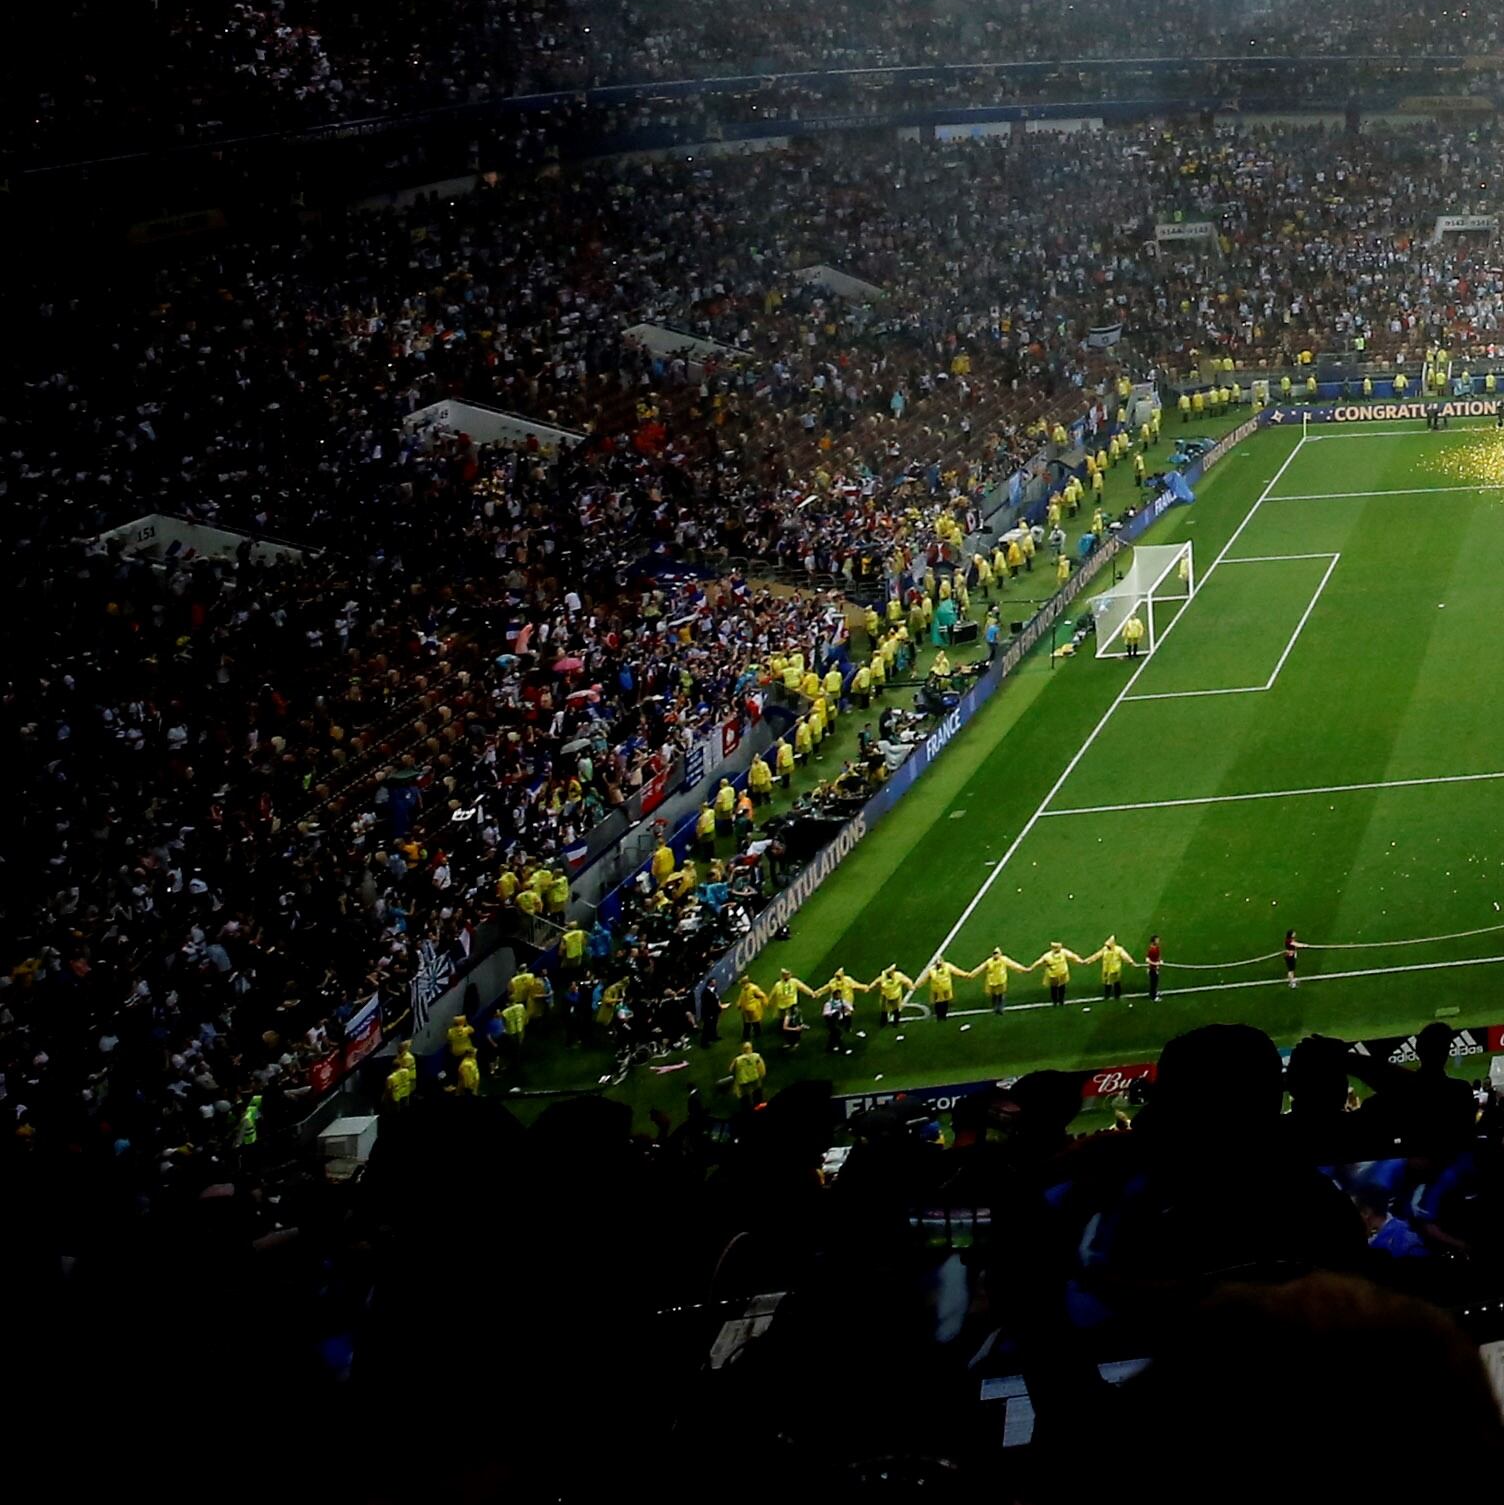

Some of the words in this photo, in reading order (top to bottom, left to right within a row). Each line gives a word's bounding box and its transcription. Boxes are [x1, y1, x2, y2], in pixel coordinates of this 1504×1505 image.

[137, 526, 156, 542] 151
[926, 707, 961, 762] FRANCE
[735, 810, 867, 972] CONGRATULATIONS
